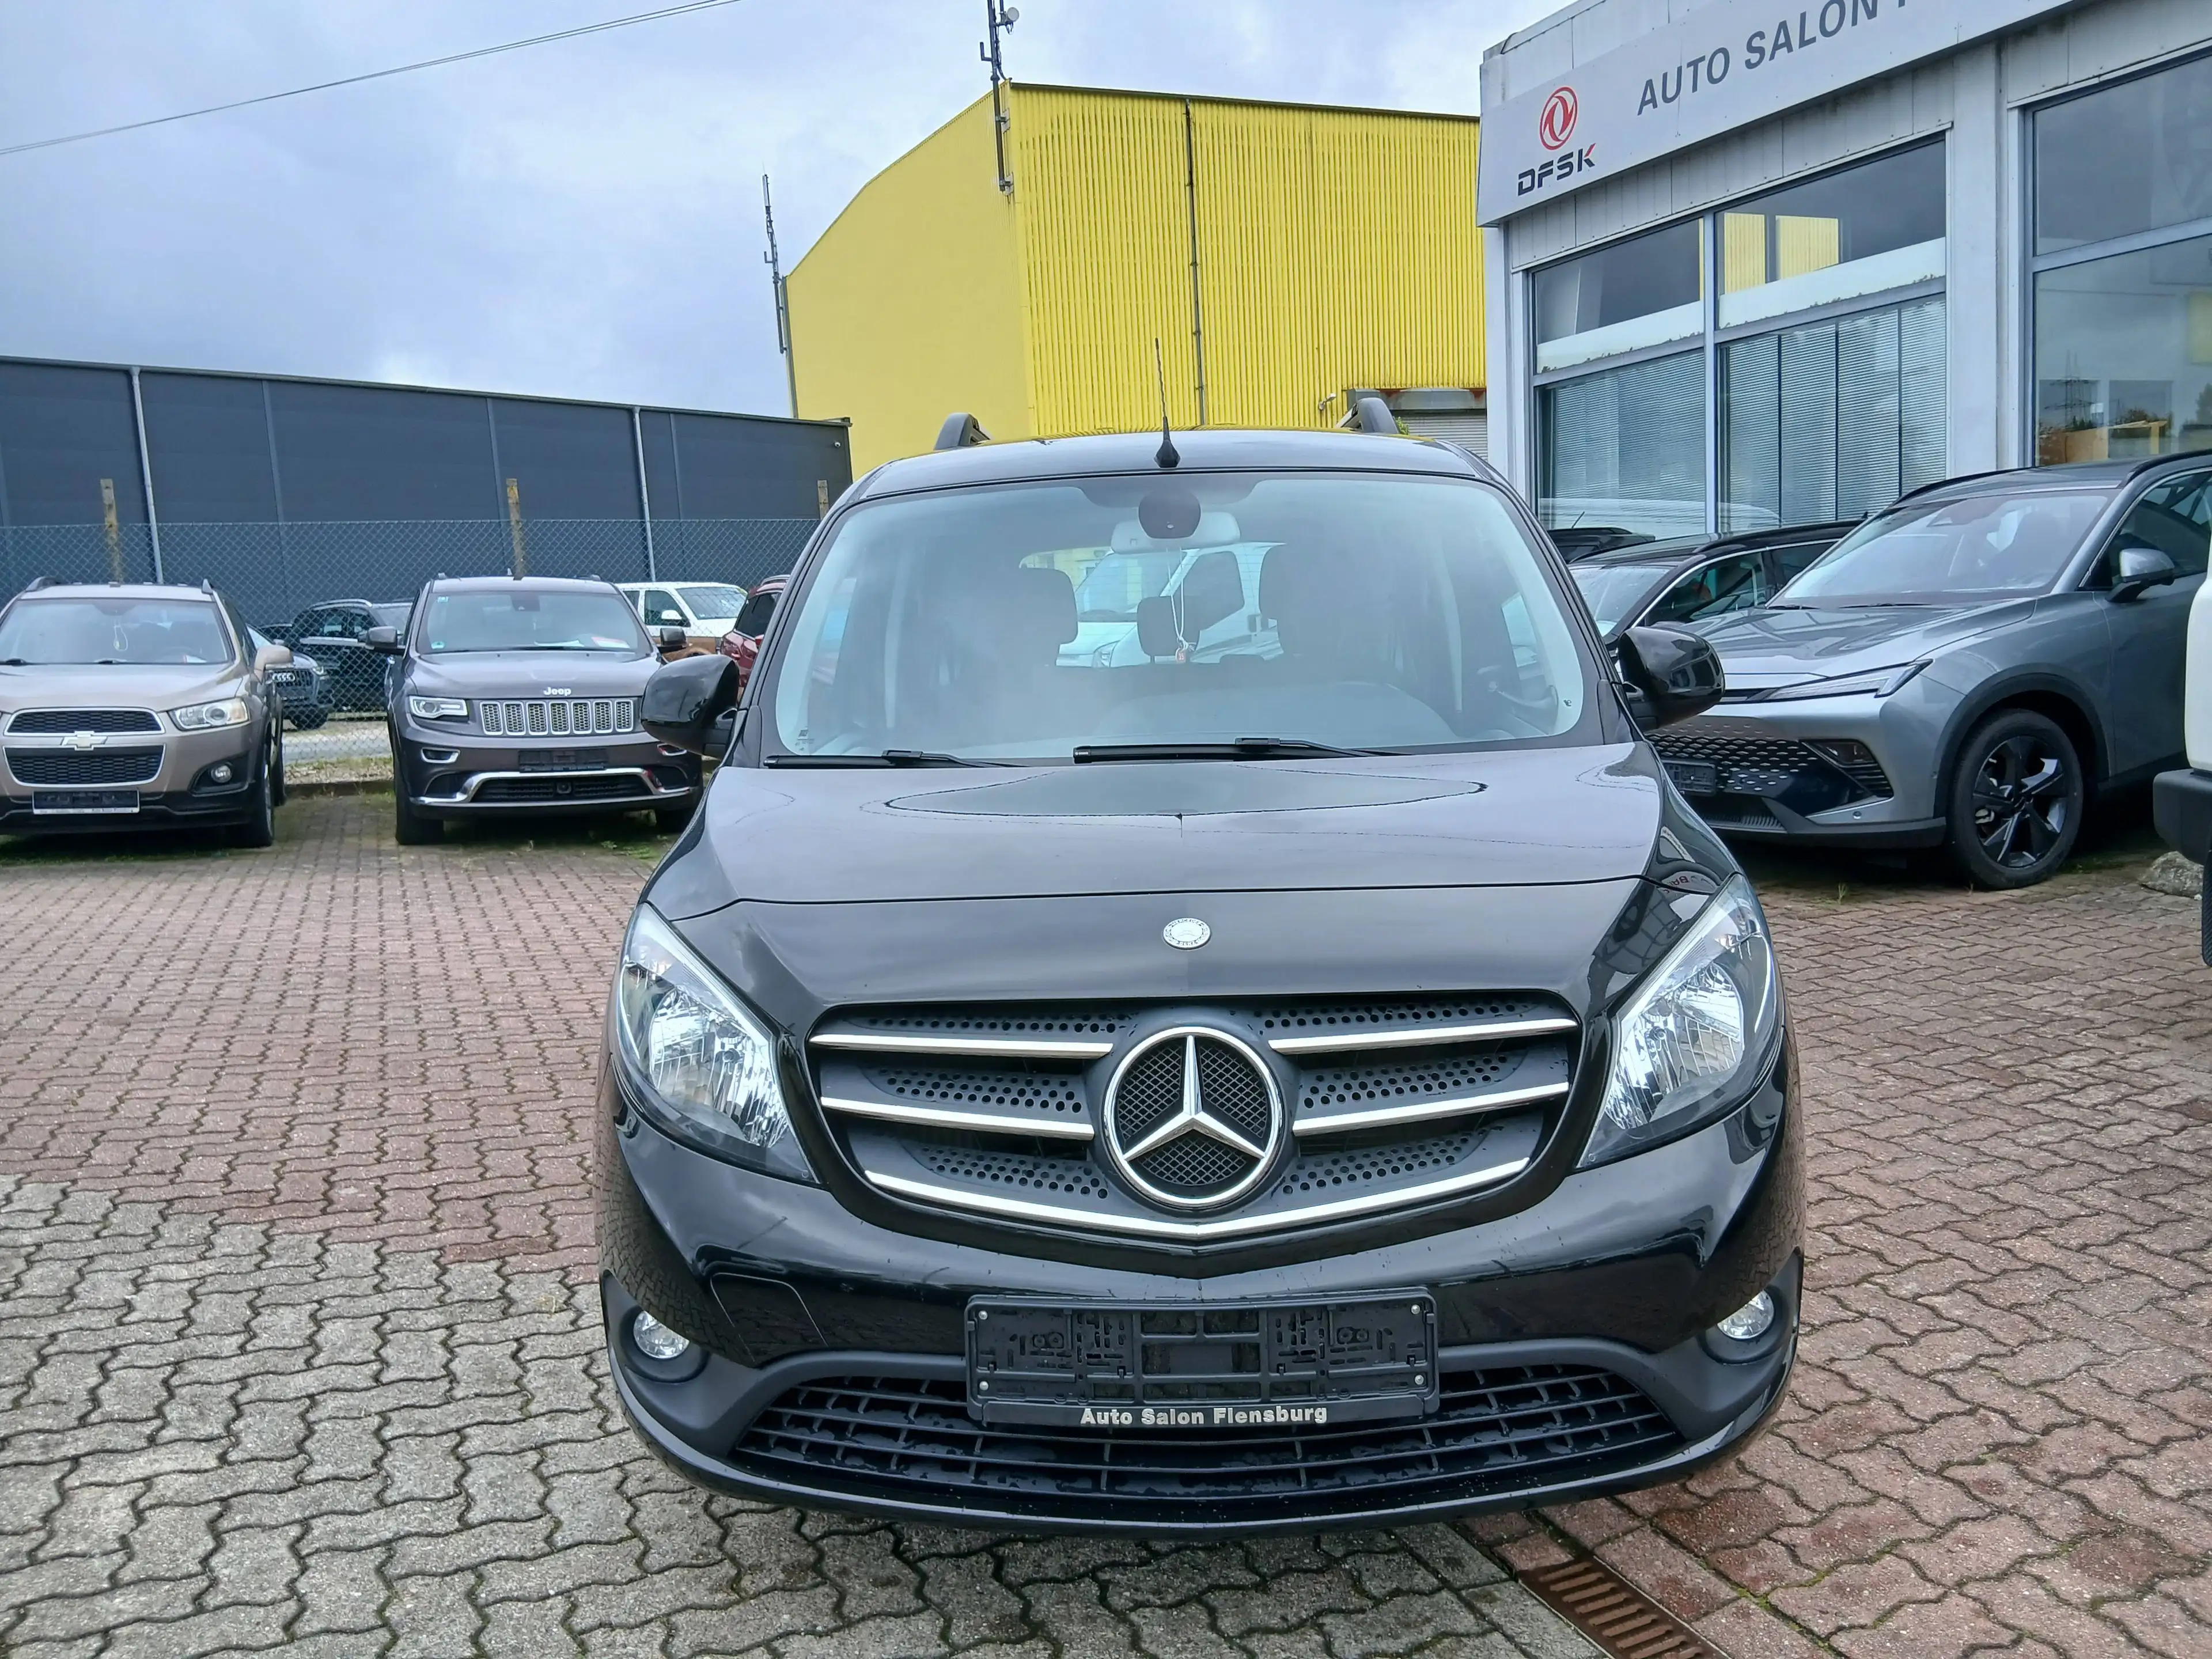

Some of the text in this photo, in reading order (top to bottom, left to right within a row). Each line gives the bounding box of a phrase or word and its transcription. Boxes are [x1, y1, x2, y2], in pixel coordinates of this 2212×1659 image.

[1637, 0, 1878, 116] AUTO SALON
[1517, 143, 1596, 196] DFSK
[1080, 1406, 1328, 1425] Auto Salon Flensburg
